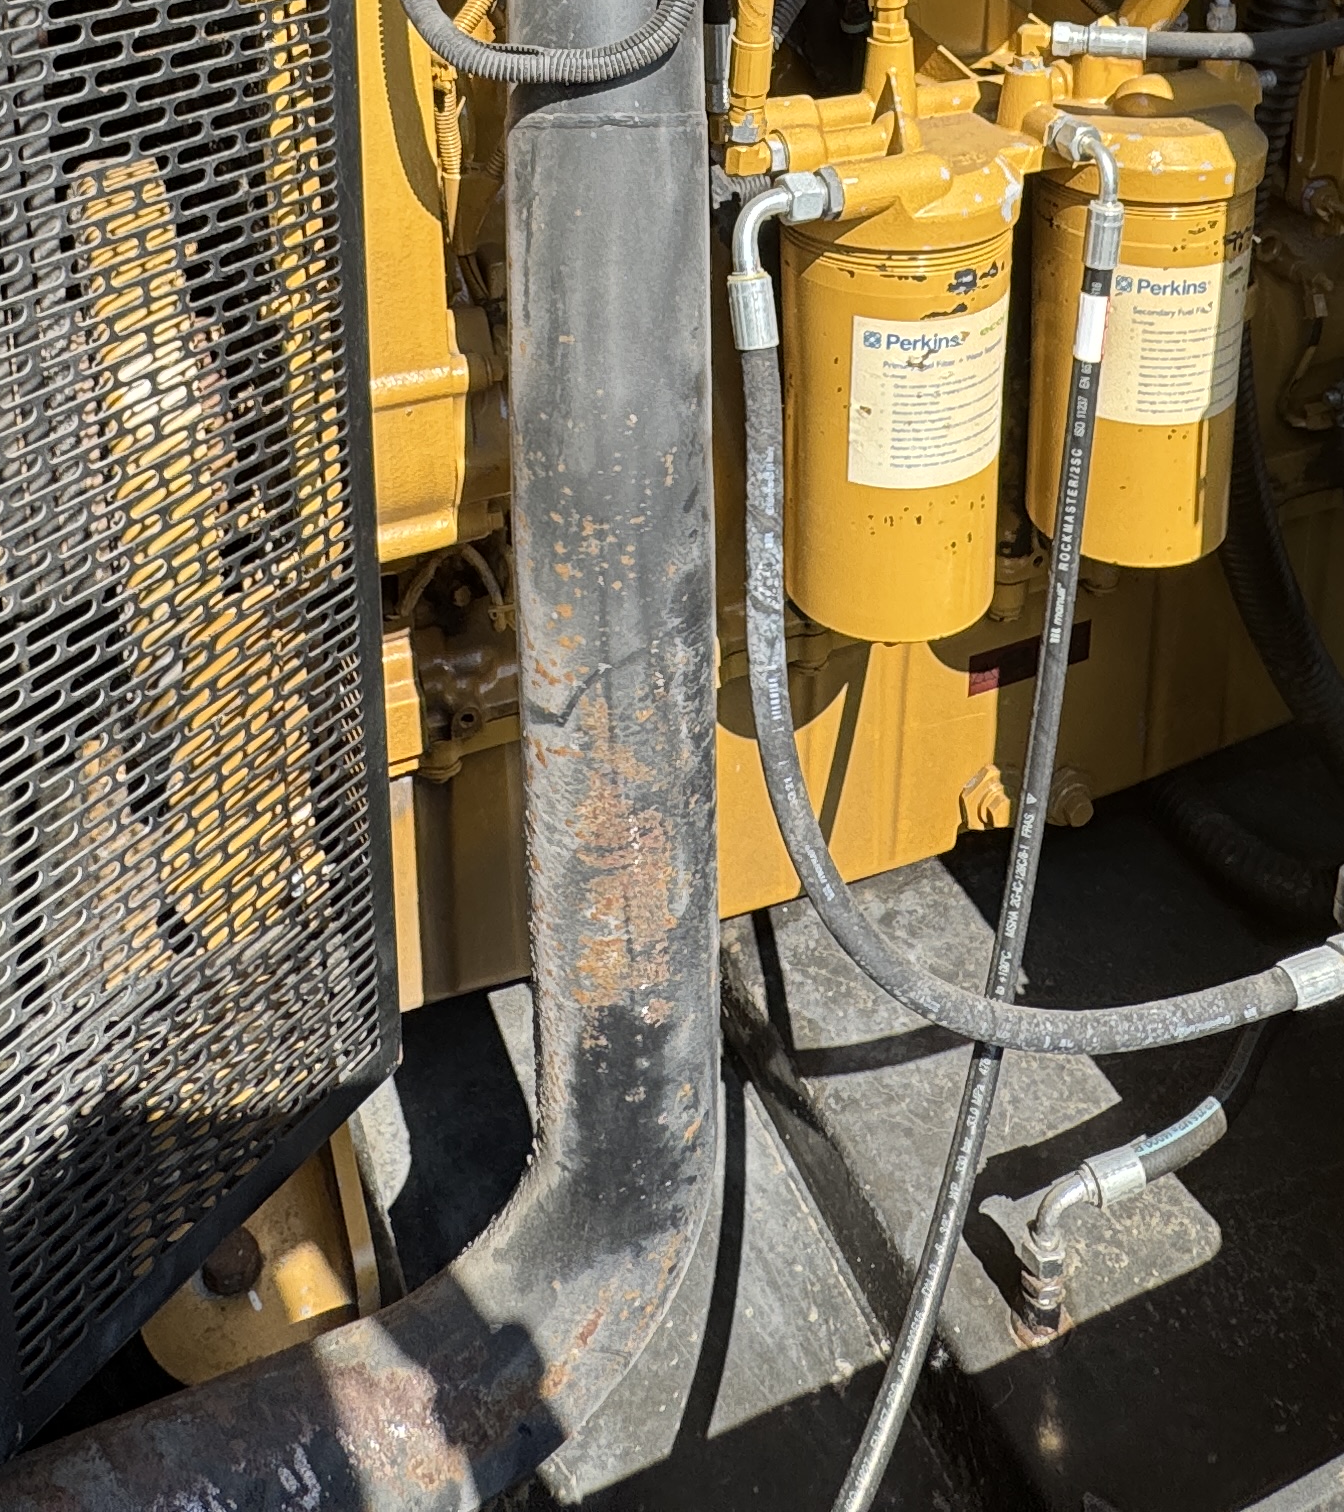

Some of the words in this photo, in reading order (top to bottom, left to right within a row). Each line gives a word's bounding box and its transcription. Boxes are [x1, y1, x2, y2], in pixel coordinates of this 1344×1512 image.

[1137, 278, 1207, 296] Perkins
[886, 333, 962, 352] Perkins
[1073, 420, 1086, 438] ISO
[1057, 447, 1083, 572] ROCKMASTER/2SC
